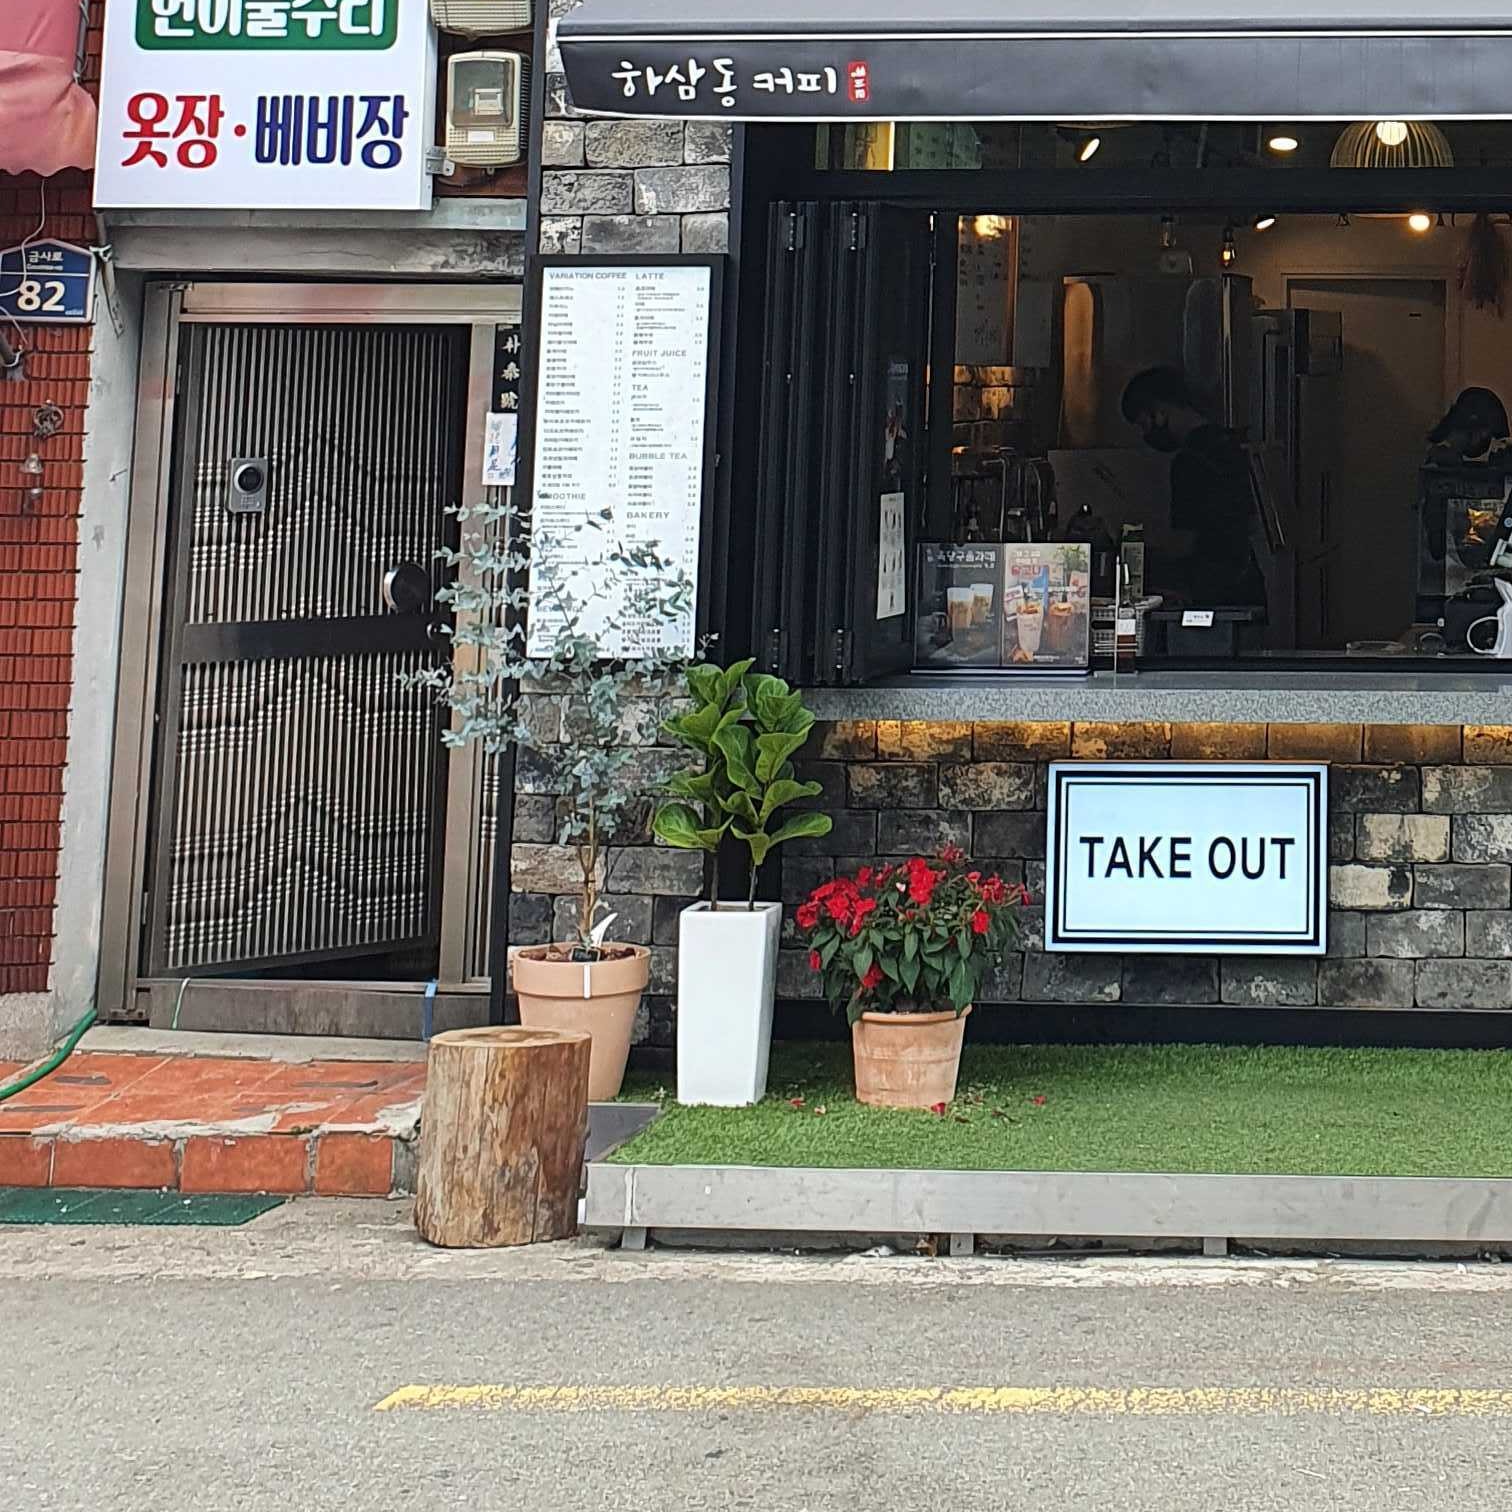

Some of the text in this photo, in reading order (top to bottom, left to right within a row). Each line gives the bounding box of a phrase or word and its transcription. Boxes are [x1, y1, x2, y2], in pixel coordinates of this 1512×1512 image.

[610, 57, 838, 108] 하삼동 커피
[549, 272, 594, 280] VARIATION
[17, 280, 65, 311] 82
[669, 452, 687, 460] TEA
[627, 511, 670, 519] BAKERY
[1079, 836, 1295, 879] TAKE OUT
